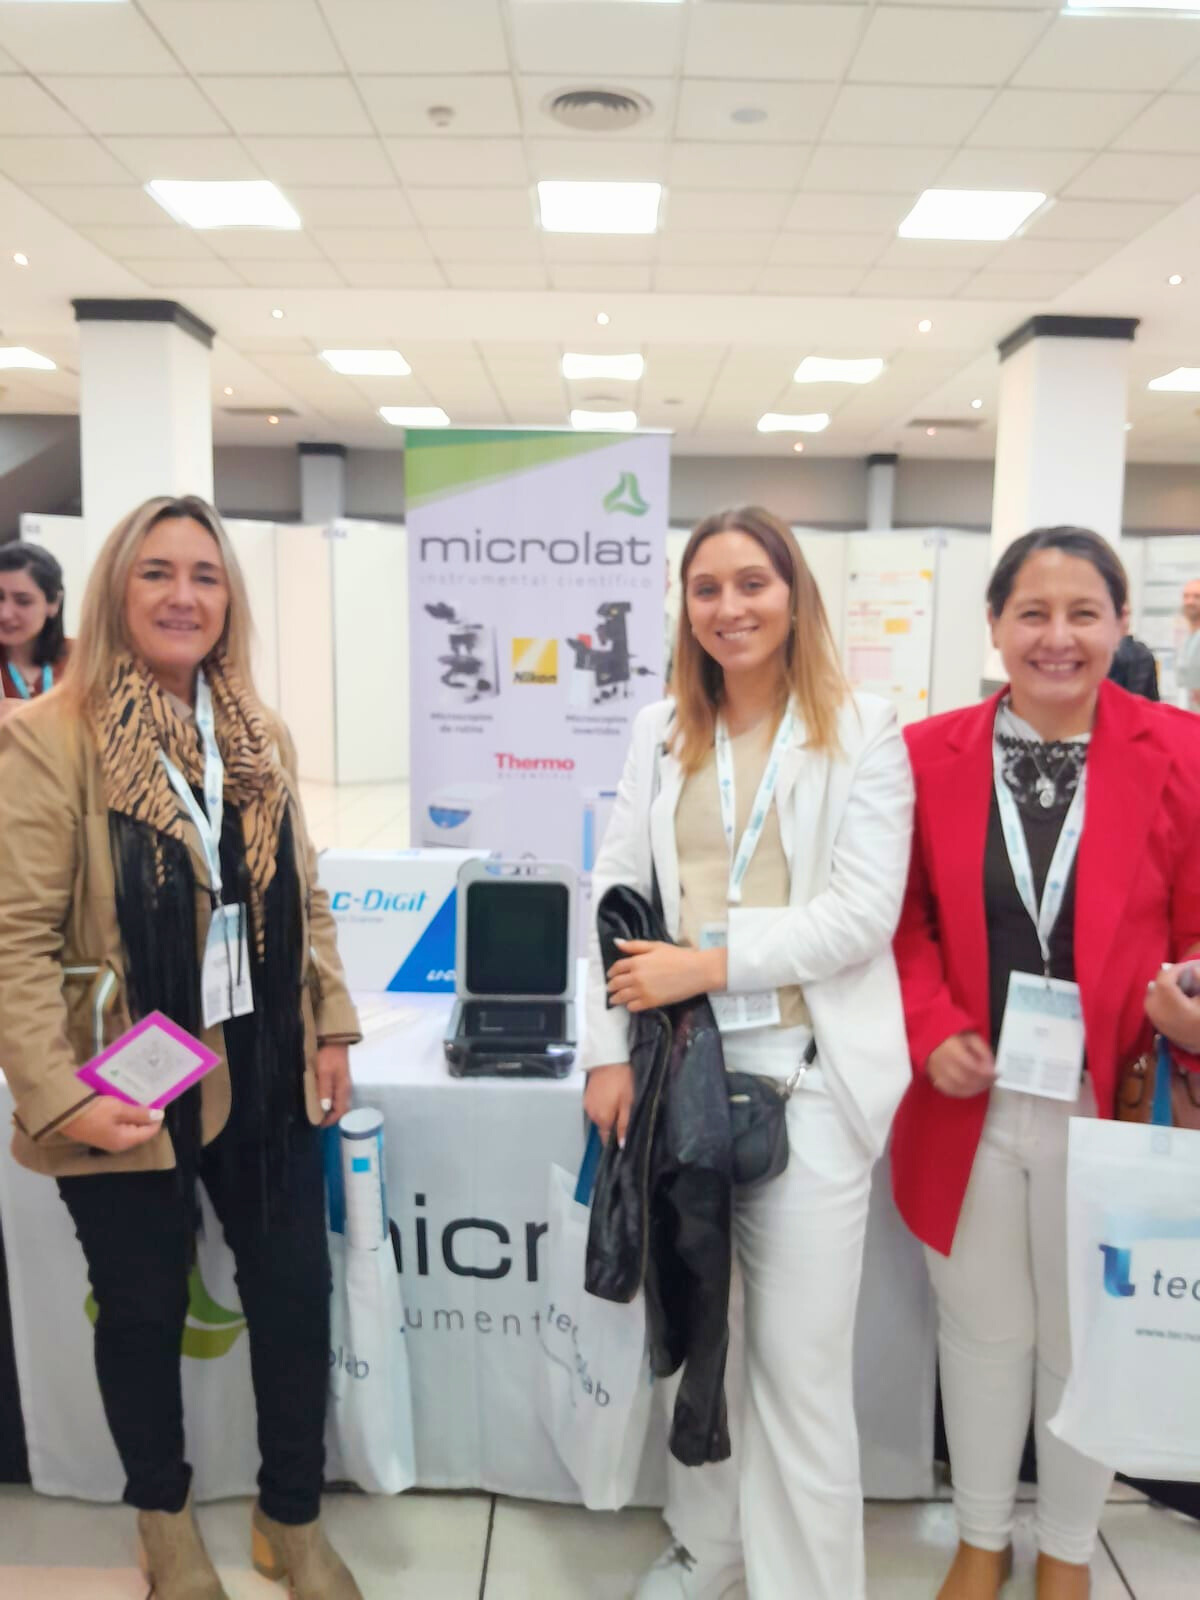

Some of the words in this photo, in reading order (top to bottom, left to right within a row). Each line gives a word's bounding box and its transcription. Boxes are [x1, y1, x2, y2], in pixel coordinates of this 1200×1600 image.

[420, 528, 652, 566] microlat
[512, 671, 557, 685] Nikon
[494, 752, 575, 771] Thermo
[1153, 1269, 1200, 1302] tec
[403, 1306, 541, 1335] ument
